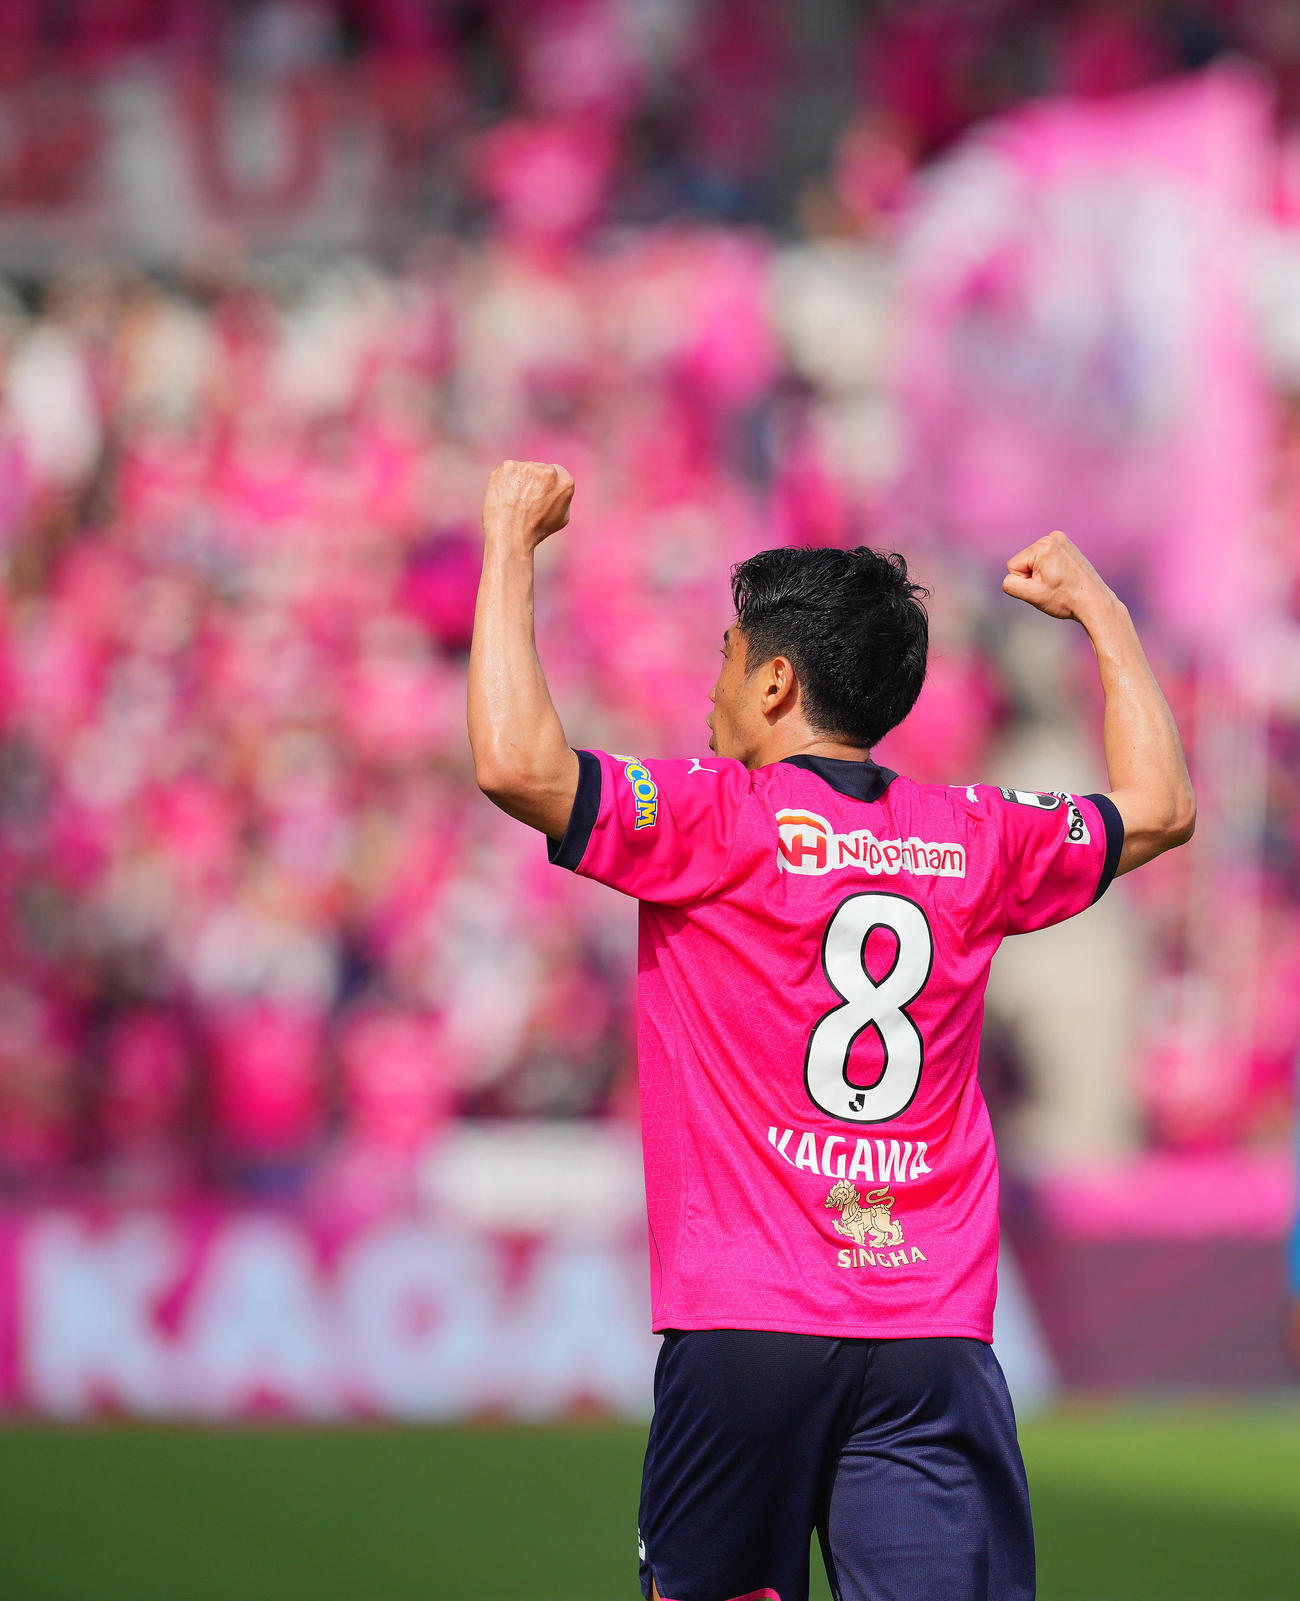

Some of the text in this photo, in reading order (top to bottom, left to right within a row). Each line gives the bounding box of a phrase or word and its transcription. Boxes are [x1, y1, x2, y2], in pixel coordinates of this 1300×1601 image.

[804, 891, 934, 1124] 8
[767, 1126, 933, 1182] KAGAWA
[837, 1247, 928, 1268] SINGHA
